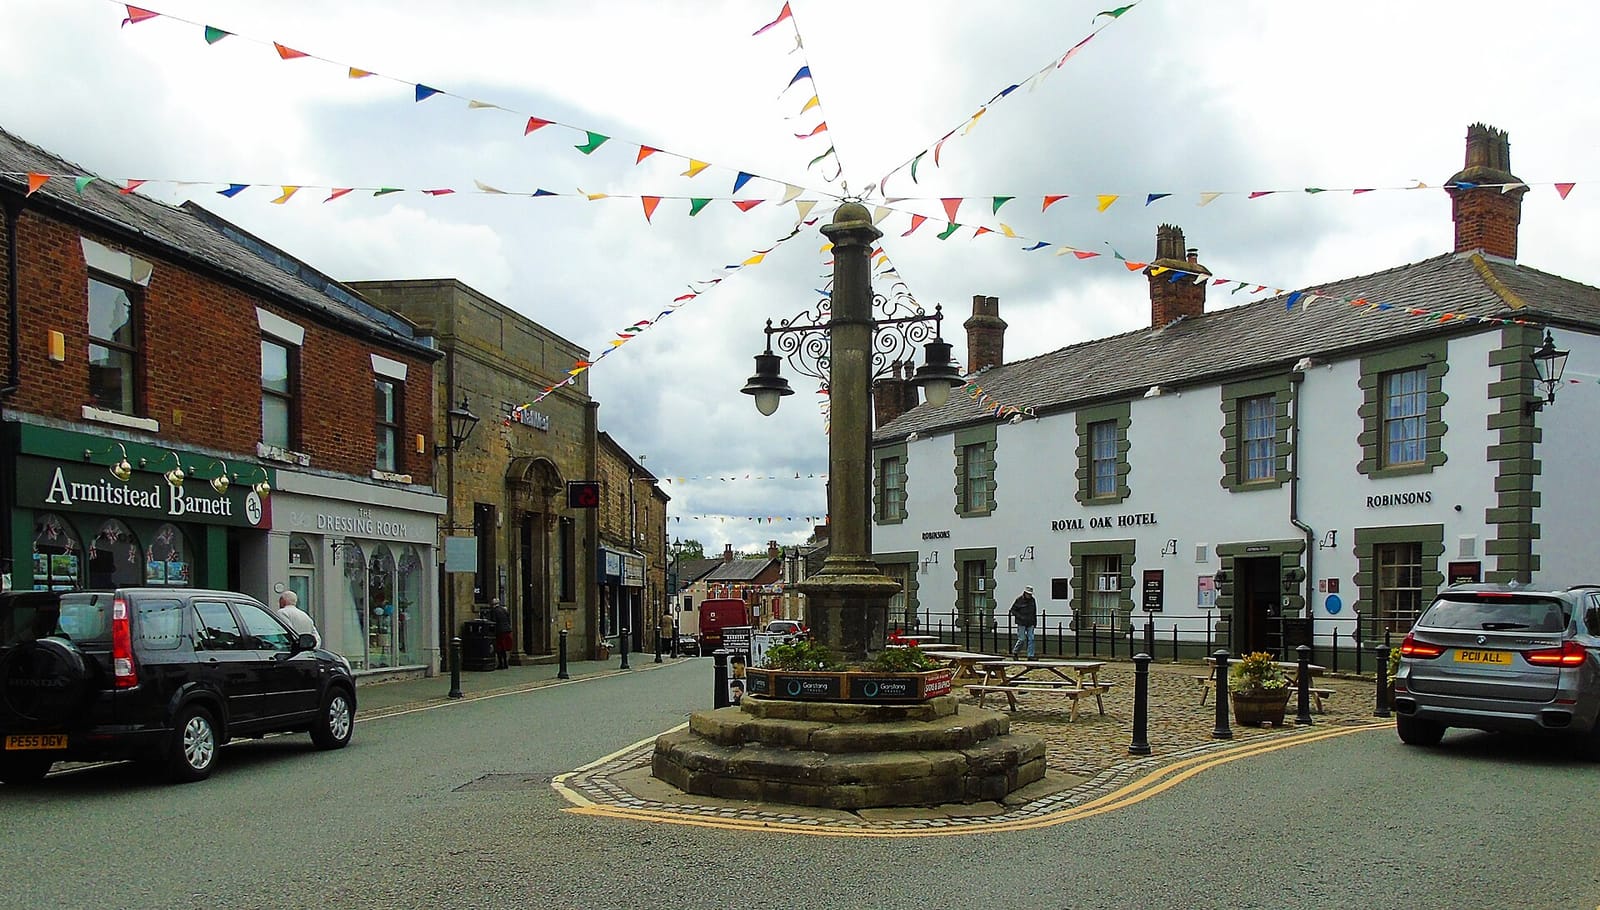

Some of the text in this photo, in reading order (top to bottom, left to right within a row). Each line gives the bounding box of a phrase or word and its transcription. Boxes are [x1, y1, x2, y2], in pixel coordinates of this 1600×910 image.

[45, 467, 232, 516] Armitstead Barnett
[1366, 491, 1432, 508] ROBINSONS
[359, 508, 372, 519] THE
[318, 514, 407, 537] DRESSING ROOM
[1051, 513, 1157, 531] ROYAL OAK HOTEL
[1483, 652, 1502, 662] ALL
[803, 682, 828, 690] Garstang
[10, 736, 39, 747] PE55
